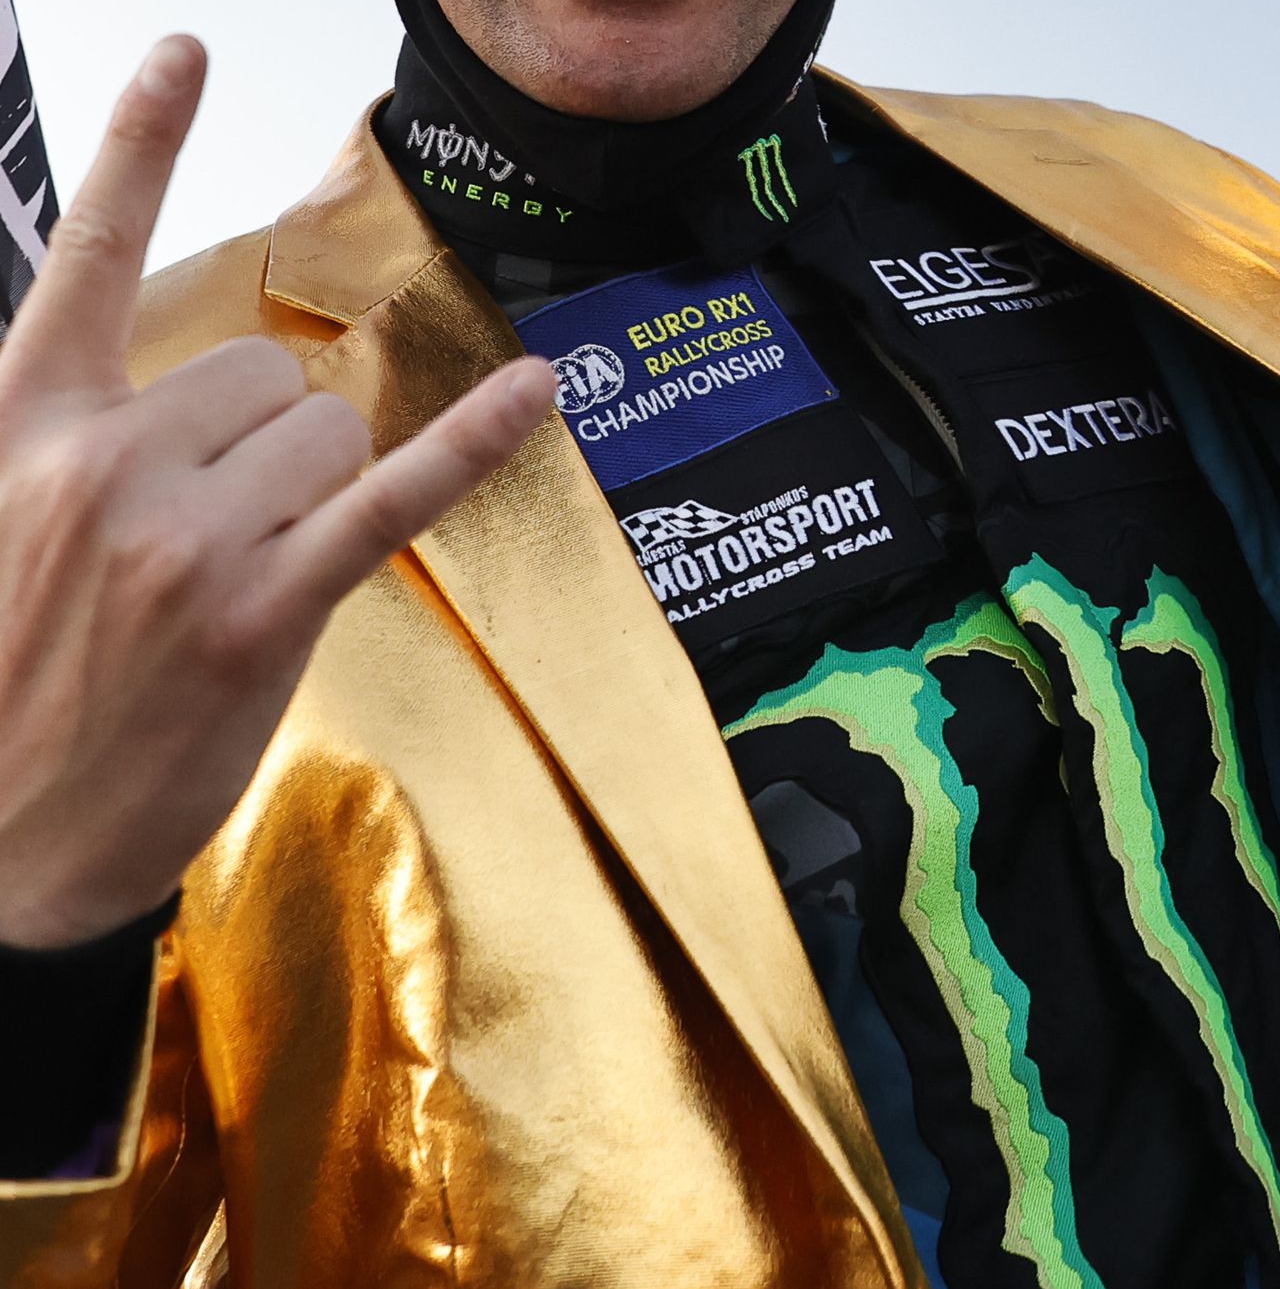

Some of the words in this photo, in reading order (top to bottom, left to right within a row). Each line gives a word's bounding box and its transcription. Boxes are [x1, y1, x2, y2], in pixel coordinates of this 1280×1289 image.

[423, 169, 573, 223] ENERGY
[626, 306, 706, 351] EURO
[707, 291, 757, 323] RX1
[643, 319, 773, 378] RALLYCROSS
[577, 344, 786, 442] CHAMPIONSHIP
[994, 390, 1176, 461] DEXTERA
[740, 485, 809, 526] STAPONKUS
[642, 479, 882, 603] MOTORSPORT
[666, 552, 816, 624] ALLYCROSS
[822, 525, 893, 560] TEAM
